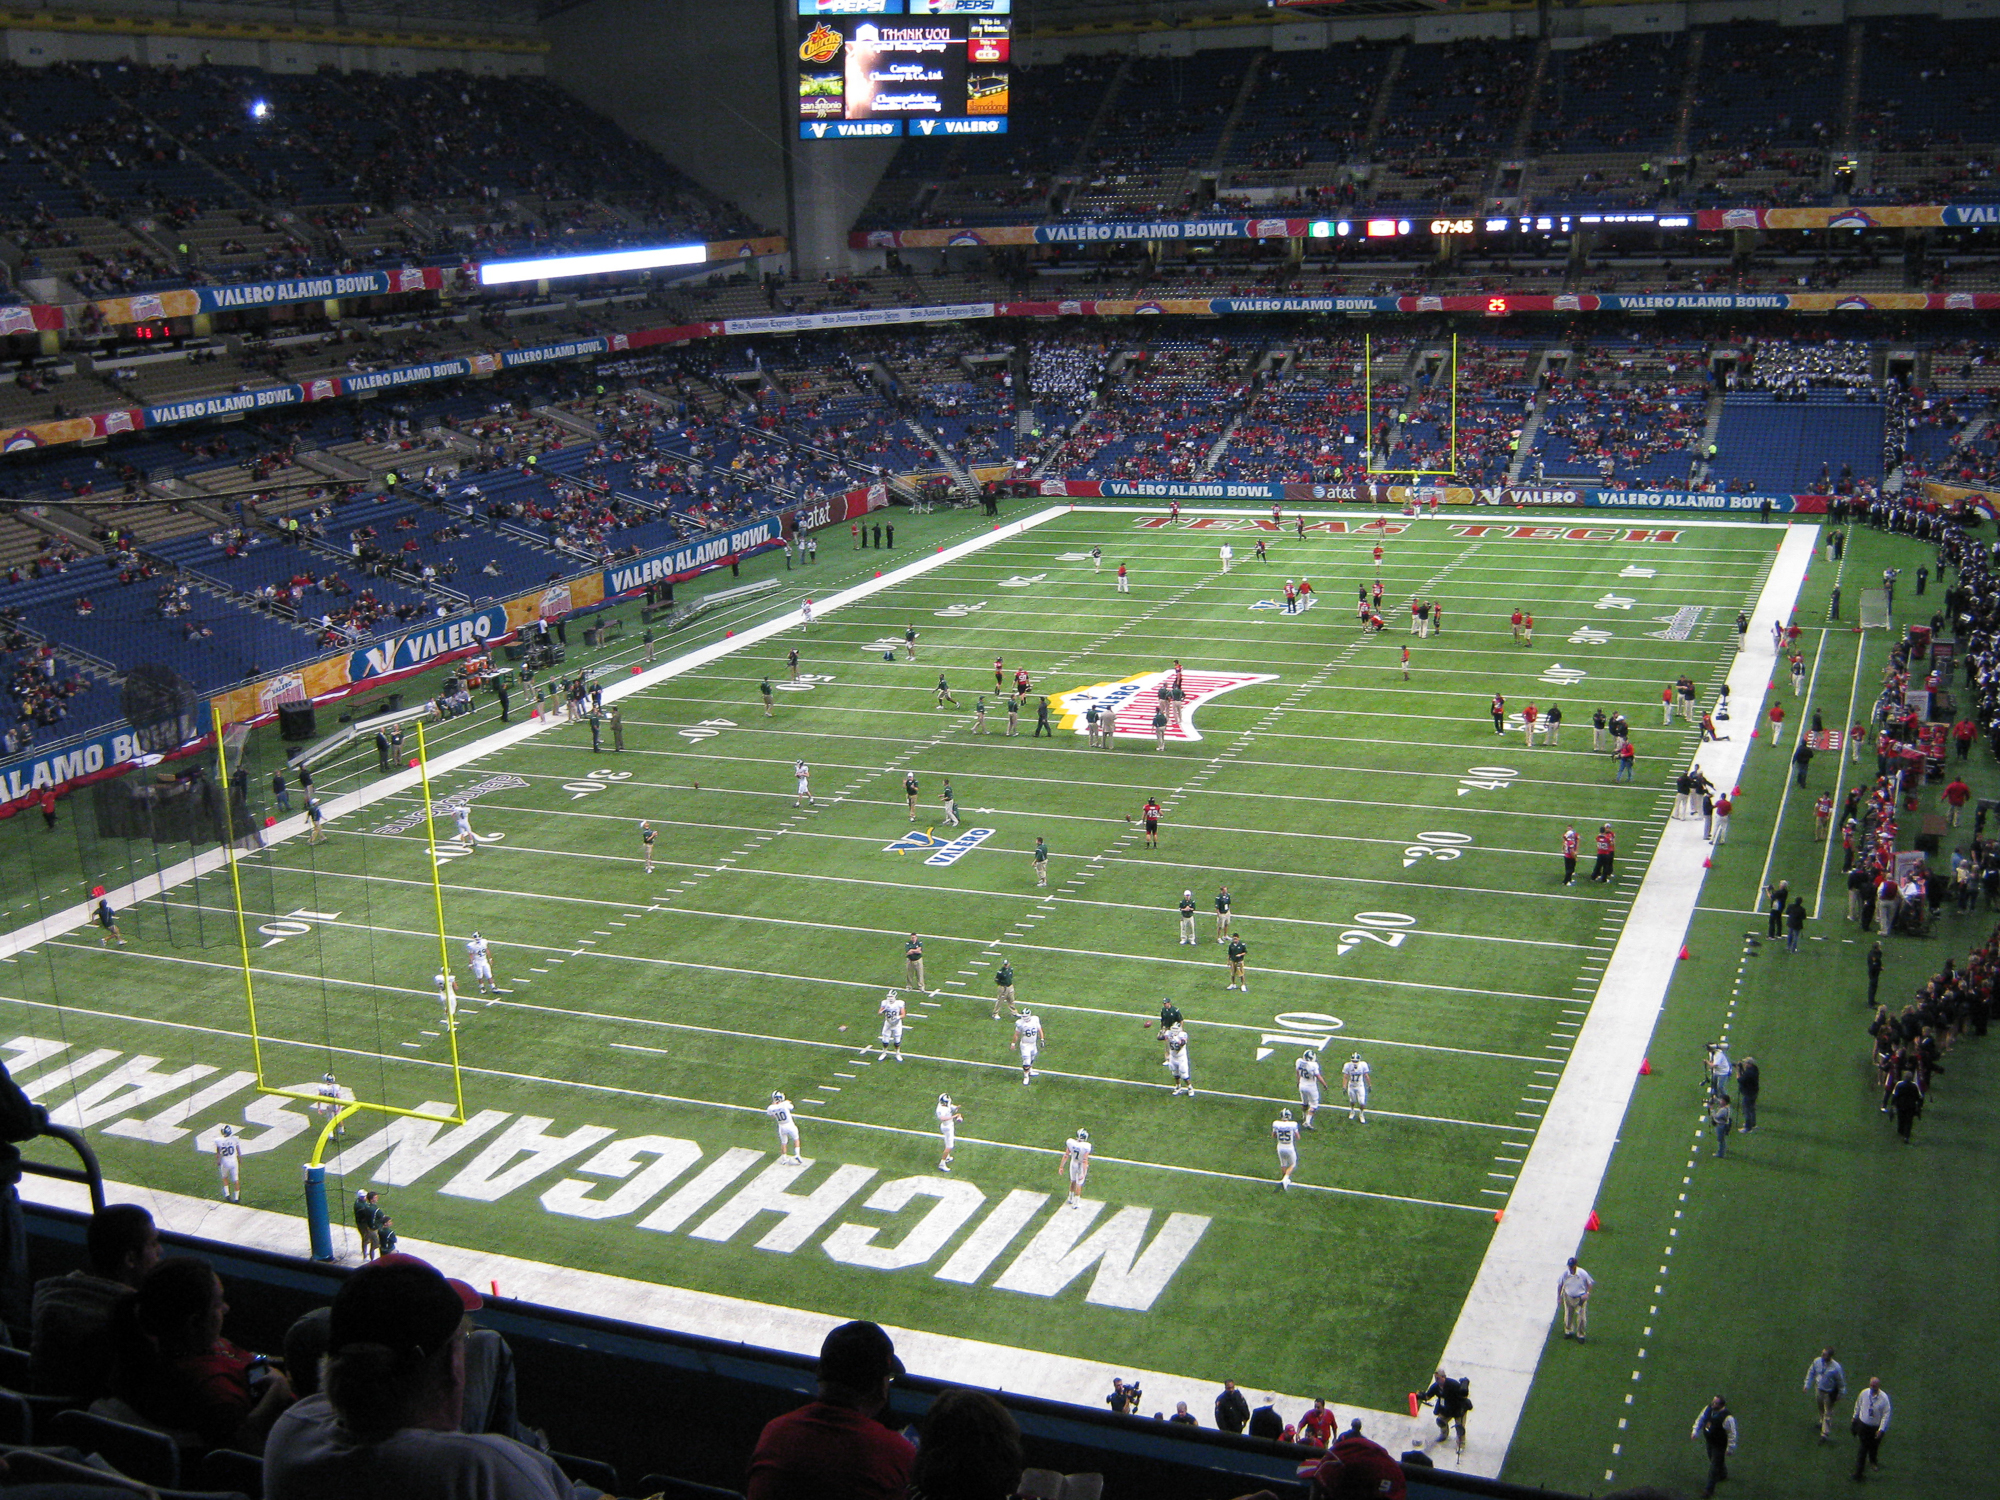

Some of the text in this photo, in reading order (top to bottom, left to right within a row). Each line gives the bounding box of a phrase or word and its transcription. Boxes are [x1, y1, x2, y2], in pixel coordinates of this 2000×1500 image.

[955, 0, 994, 10] PEPSI
[838, 123, 893, 136] VALERO
[945, 121, 999, 133] VALERO
[1957, 207, 2000, 222] VAL
[1046, 223, 1237, 241] VALERO ALAMO BOWL
[1431, 220, 1473, 234] 67:45
[213, 275, 379, 307] VALERO ALAMO BOWL
[1231, 299, 1377, 311] VALERO ALAMO BOWL
[1489, 298, 1505, 312] 25
[1620, 297, 1781, 308] VALERO ALAMO BOWL
[507, 339, 602, 365] VALERO ALAMO BOWL
[348, 362, 464, 391] VALERO ALAMO BOWL
[152, 388, 295, 424] VALERO ALAMO BOWL
[1111, 483, 1272, 498] VALERO ALAMO BOWL
[1327, 485, 1357, 500] at&t
[1511, 490, 1576, 504] VALERO
[1598, 492, 1662, 506] VALERO
[1664, 494, 1725, 508] ALAMO
[807, 501, 831, 528] at&t
[1133, 516, 1686, 543] TEXAS TECH
[612, 523, 771, 592] VALERO ALAMO BOWL
[407, 615, 491, 662] VALERO
[562, 768, 633, 794] 30
[1459, 766, 1518, 790] 40
[929, 828, 990, 865] VALERO
[1404, 831, 1472, 861] 30
[257, 906, 343, 936] 10
[1339, 911, 1416, 947] 20
[1260, 1011, 1344, 1052] 10
[775, 1111, 787, 1121] 10
[1278, 1130, 1291, 1142] 25
[221, 1145, 235, 1156] 20
[1073, 1150, 1080, 1161] 7
[319, 1100, 1212, 1312] MICHIGAN
